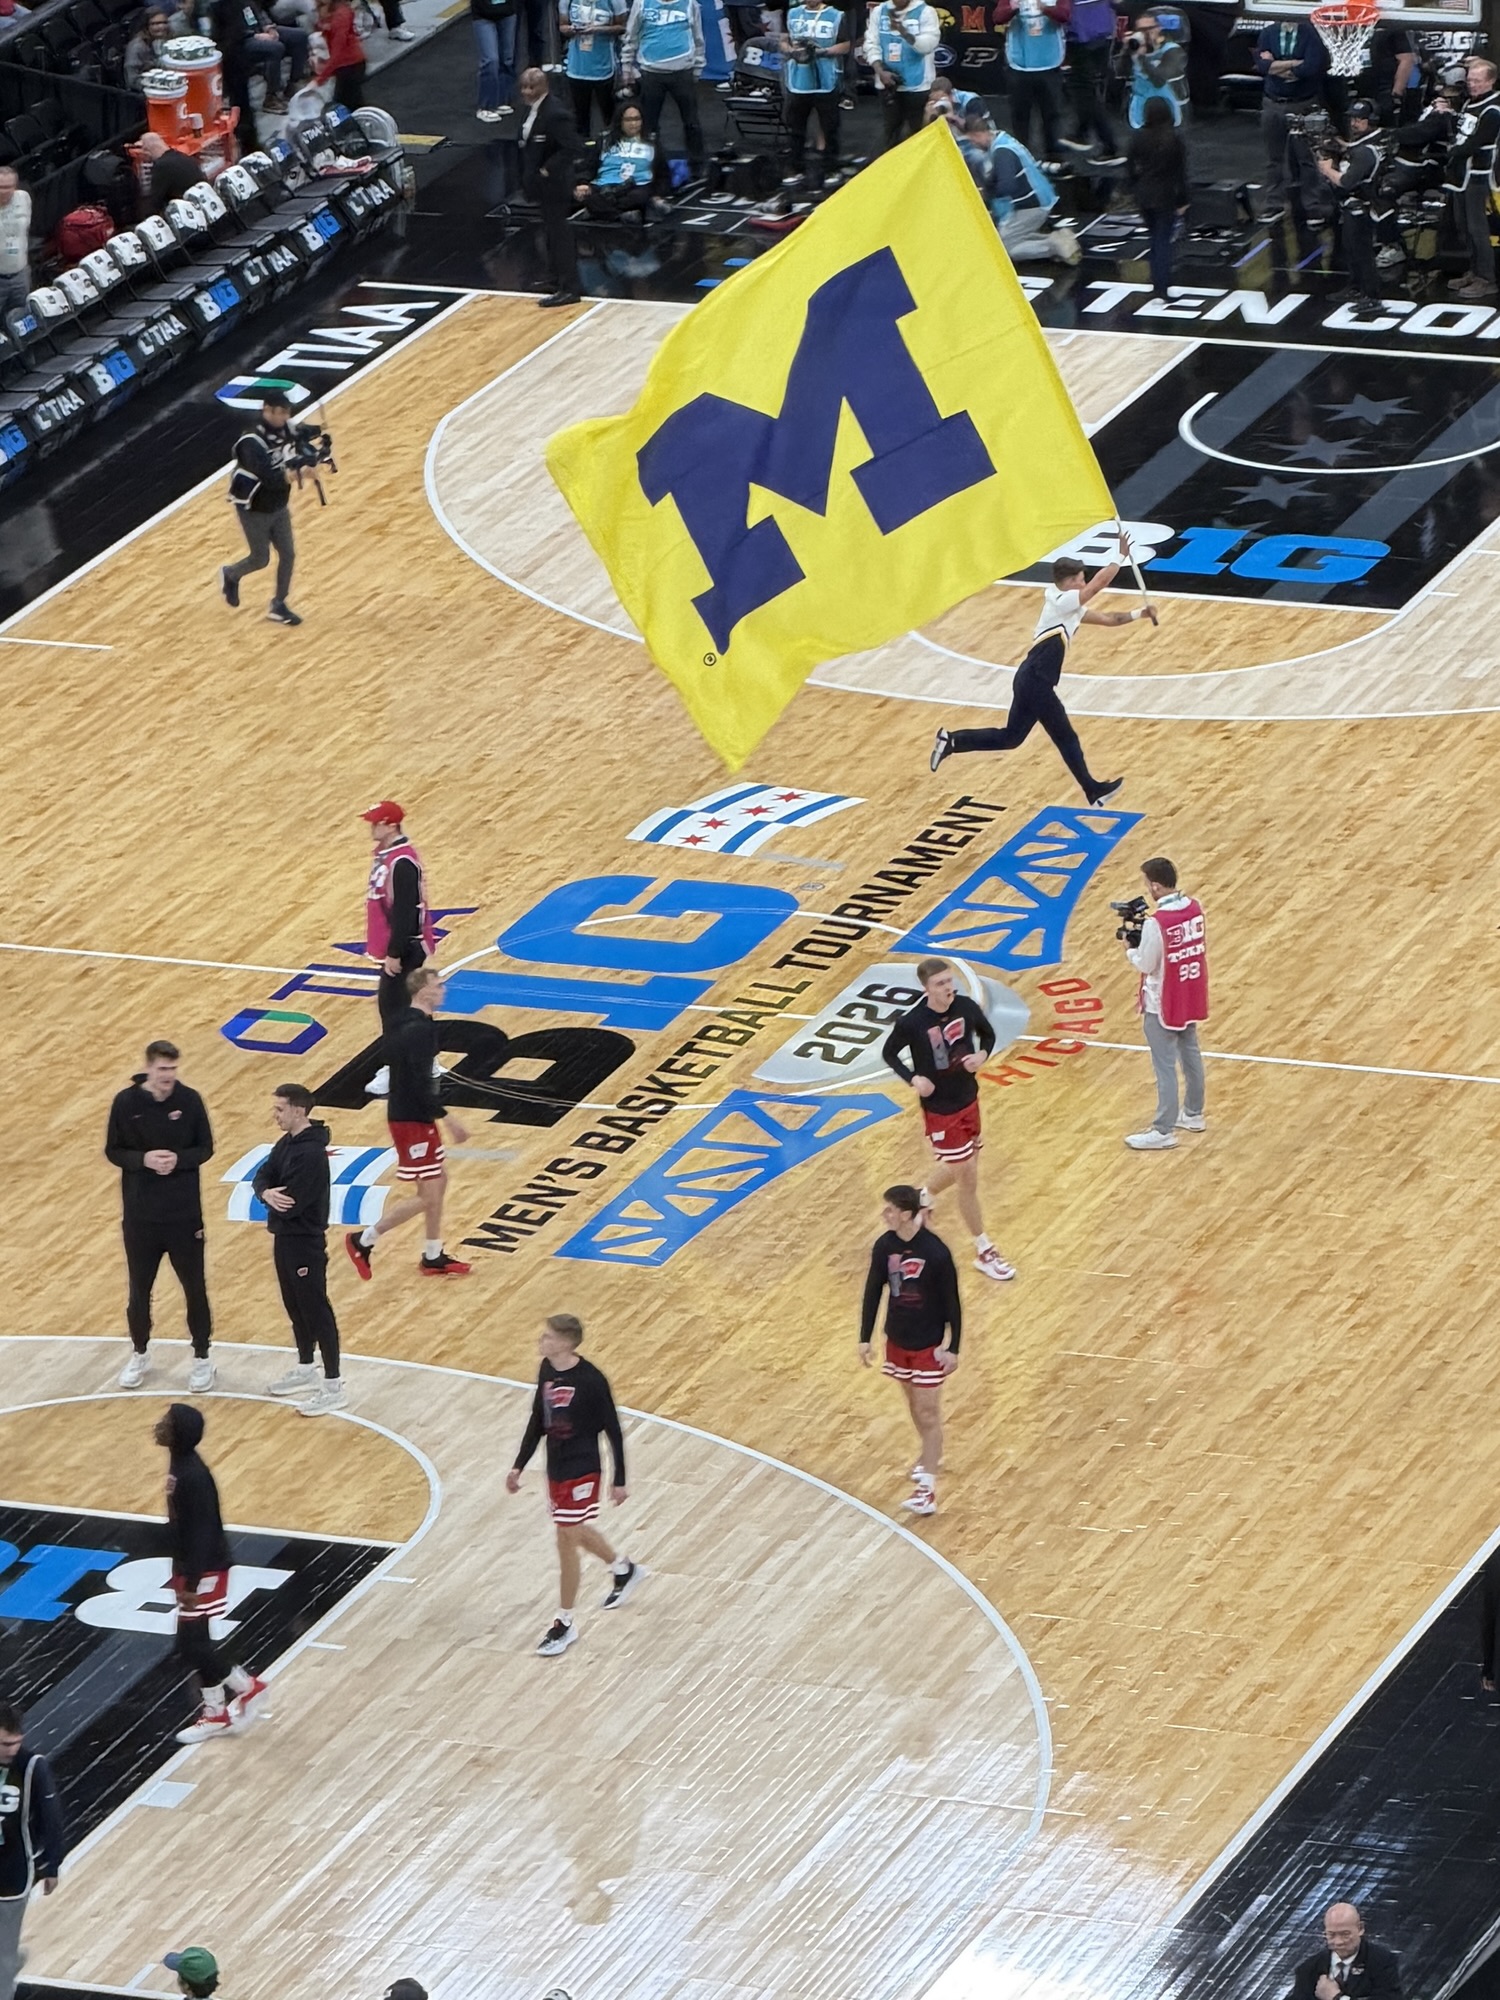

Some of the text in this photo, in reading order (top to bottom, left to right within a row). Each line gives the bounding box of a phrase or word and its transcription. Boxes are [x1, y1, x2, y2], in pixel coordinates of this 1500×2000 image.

[255, 301, 441, 373] TIAA
[1081, 280, 1312, 325] TEN
[1322, 299, 1500, 339] CO
[636, 246, 998, 656] M
[459, 795, 1009, 1254] MEN'S BASKETBALL TOURNAMENT
[793, 983, 924, 1066] 2026
[978, 977, 1105, 1087] HICAGO
